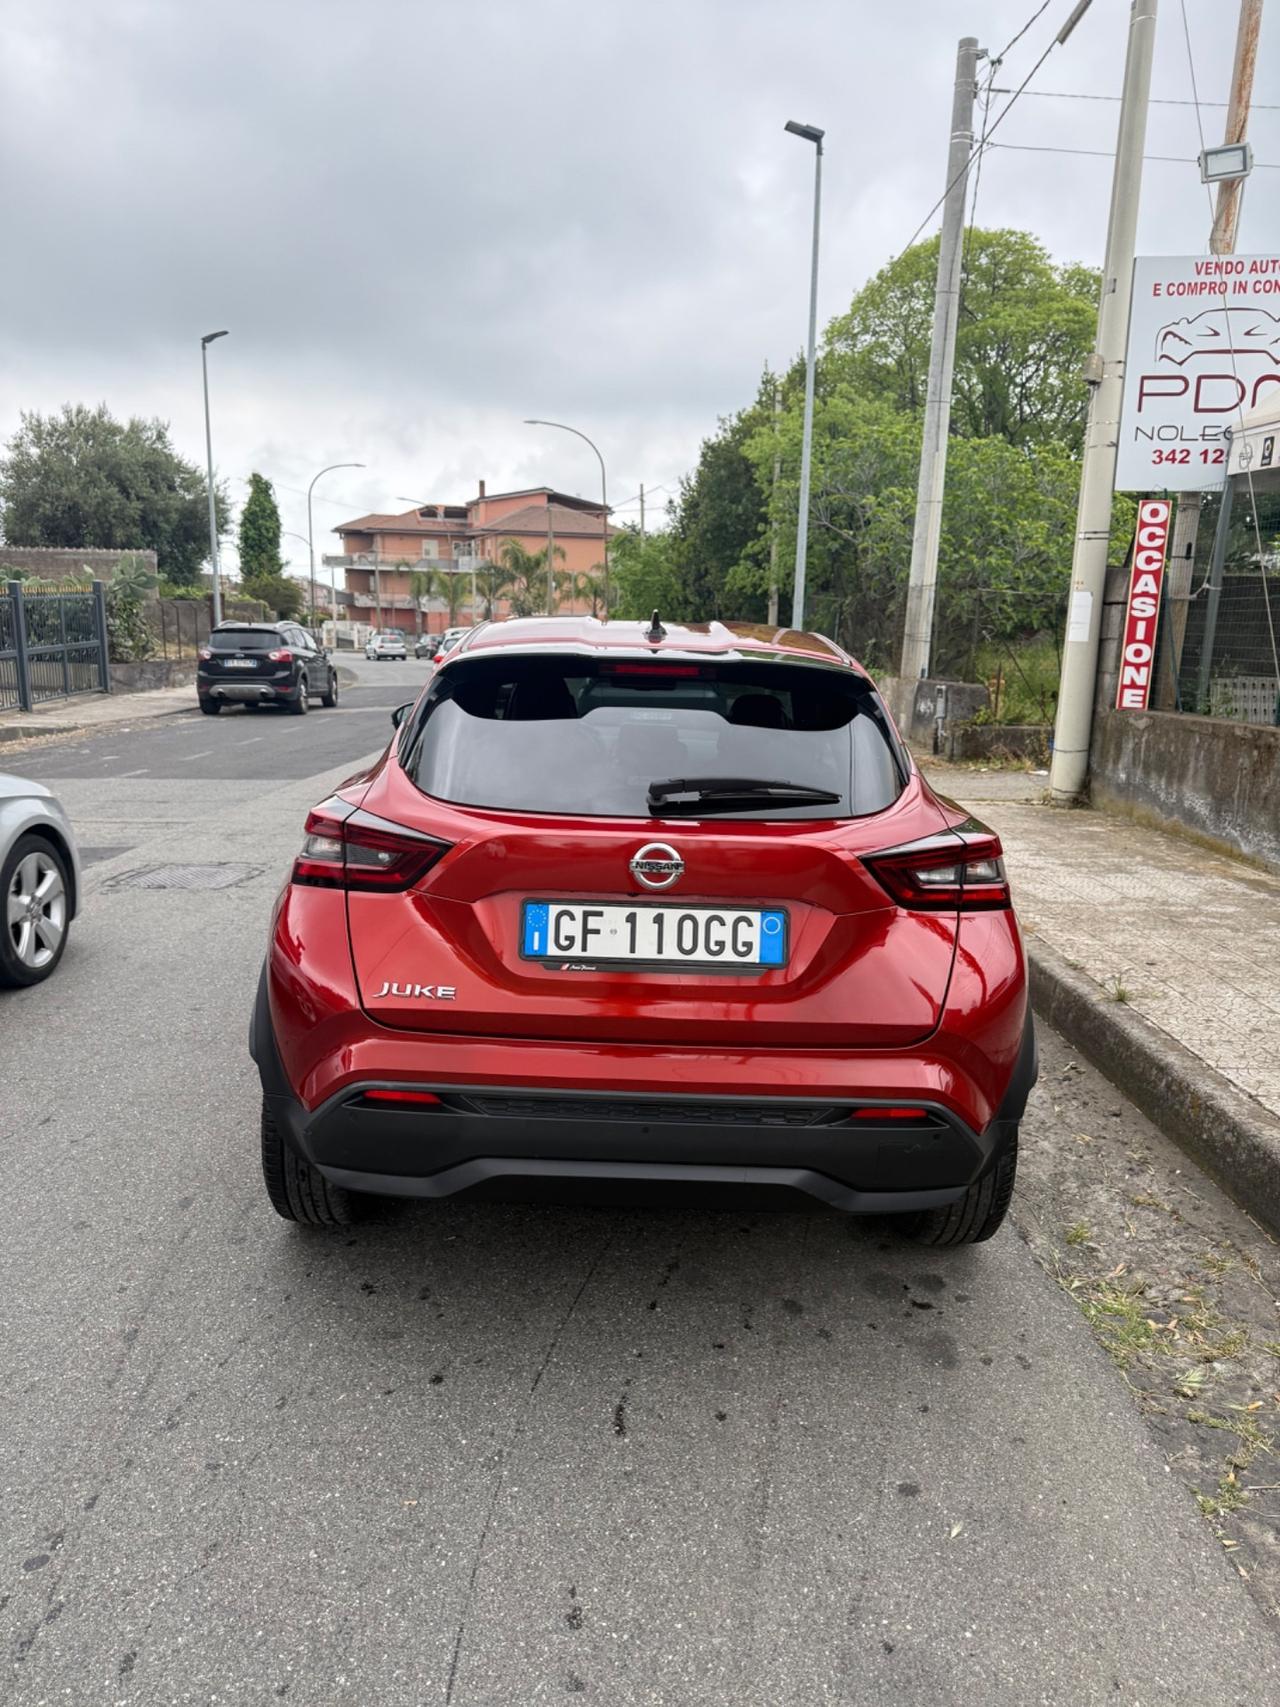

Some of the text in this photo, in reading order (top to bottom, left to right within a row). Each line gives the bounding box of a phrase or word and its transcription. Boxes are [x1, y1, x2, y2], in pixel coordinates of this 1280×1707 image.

[1195, 259, 1280, 275] VENDO AUT
[1153, 283, 1162, 297] E
[1166, 280, 1227, 296] COMPRO
[1233, 280, 1248, 294] IN
[1152, 449, 1190, 465] 342
[1122, 502, 1169, 708] OCCASIONE
[633, 861, 682, 871] NISSAN
[554, 910, 604, 953] GF
[625, 911, 754, 957] 110GG
[372, 982, 456, 1000] JUKE
